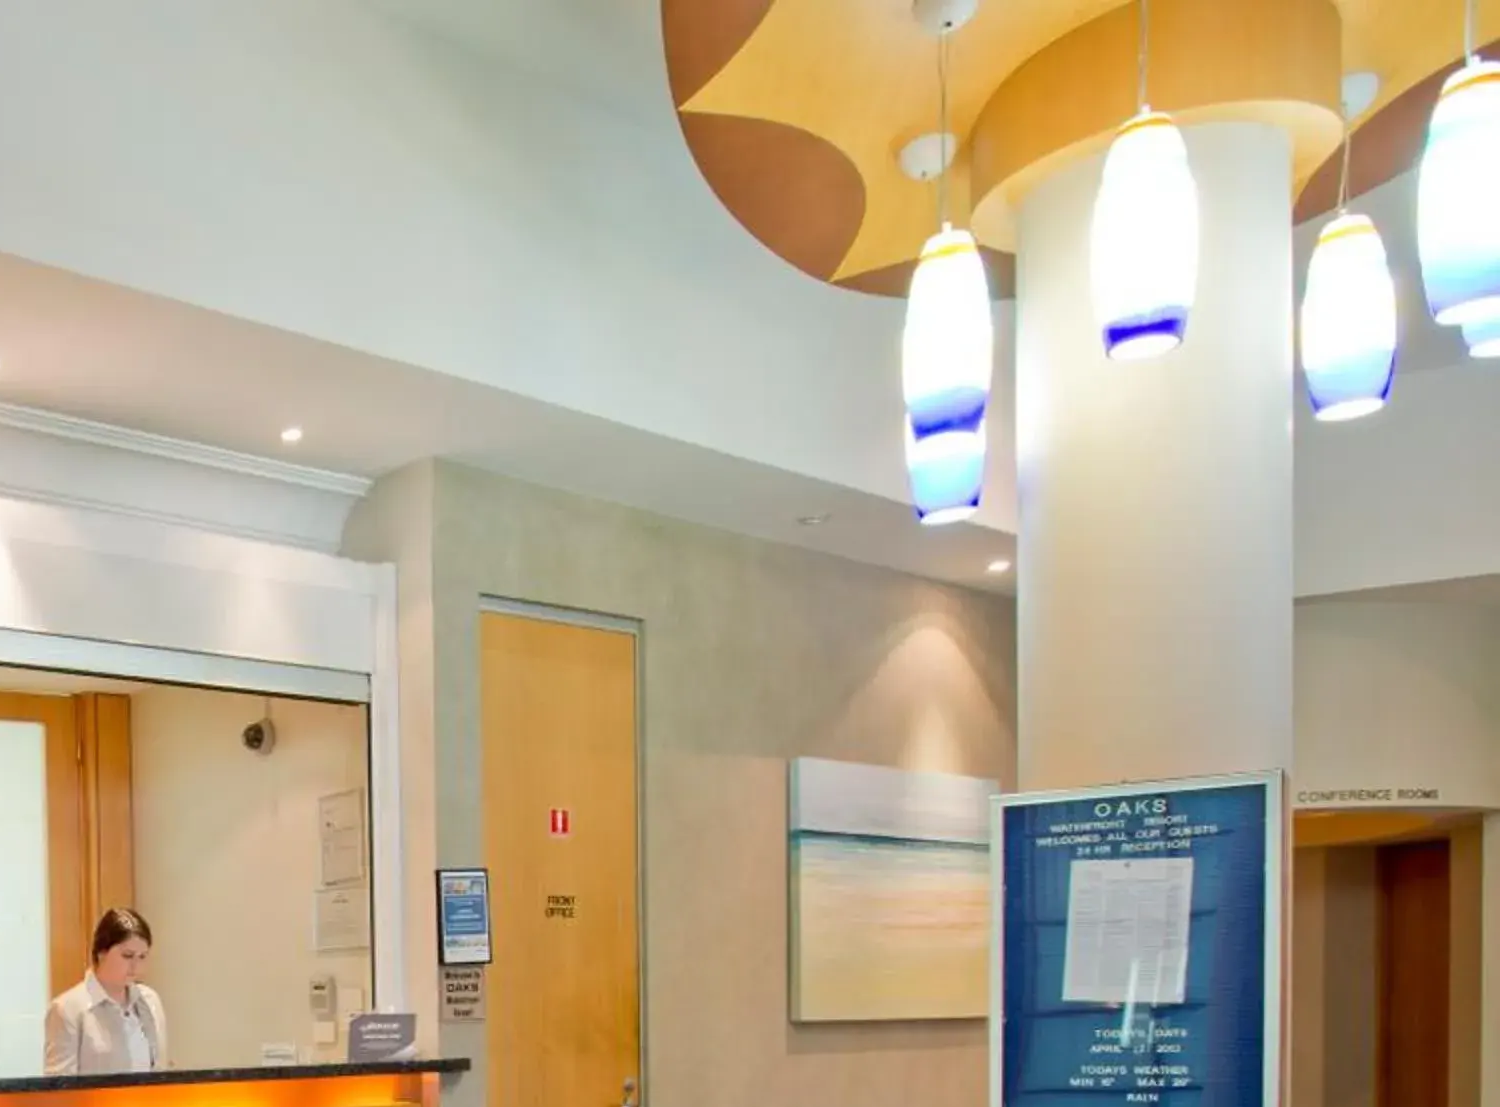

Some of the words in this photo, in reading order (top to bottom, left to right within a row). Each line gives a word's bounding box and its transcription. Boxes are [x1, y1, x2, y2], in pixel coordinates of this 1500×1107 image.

[1297, 788, 1392, 803] CONFERENCE
[1397, 788, 1440, 800] ROOMS
[1094, 799, 1167, 817] OAKS
[1050, 819, 1126, 833] WATERFRONT
[1143, 815, 1188, 827] RESORT
[1036, 834, 1101, 847] WELCOMES
[1106, 832, 1127, 841] ALL
[1135, 829, 1160, 839] OUR
[1169, 824, 1218, 837] GUESTS
[1121, 839, 1191, 852] RECEPTION
[547, 895, 575, 906] FRONT
[545, 907, 576, 918] OFFICE
[1134, 1065, 1189, 1075] WEATHER
[1069, 1078, 1094, 1087] MIN
[1137, 1078, 1165, 1087] MAX
[1126, 1093, 1159, 1102] RAIN
